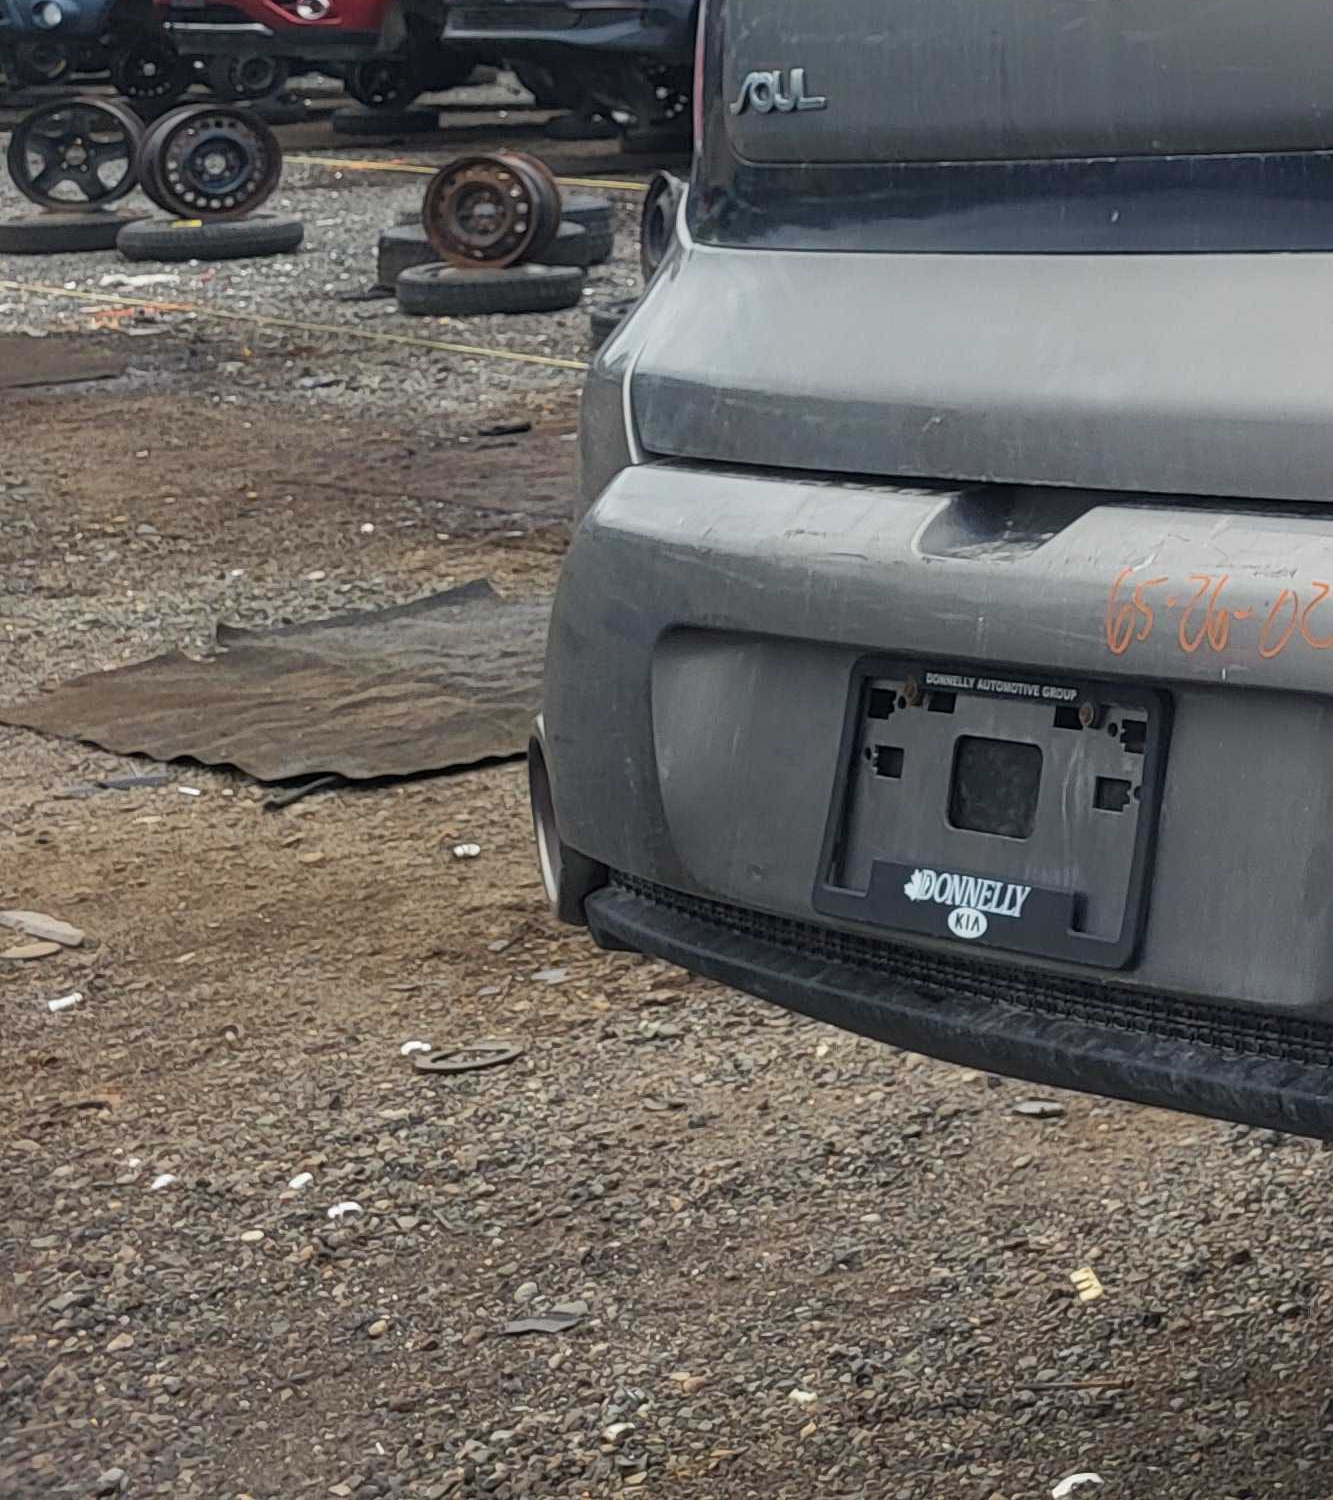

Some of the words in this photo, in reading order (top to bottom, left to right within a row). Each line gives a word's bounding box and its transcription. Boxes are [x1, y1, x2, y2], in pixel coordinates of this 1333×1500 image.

[925, 672, 976, 688] DONNELLY
[976, 678, 1040, 696] AUTOMOTIVE
[1041, 686, 1078, 701] GROUP
[918, 868, 1031, 918] DONNELLY
[954, 911, 981, 932] KIA
